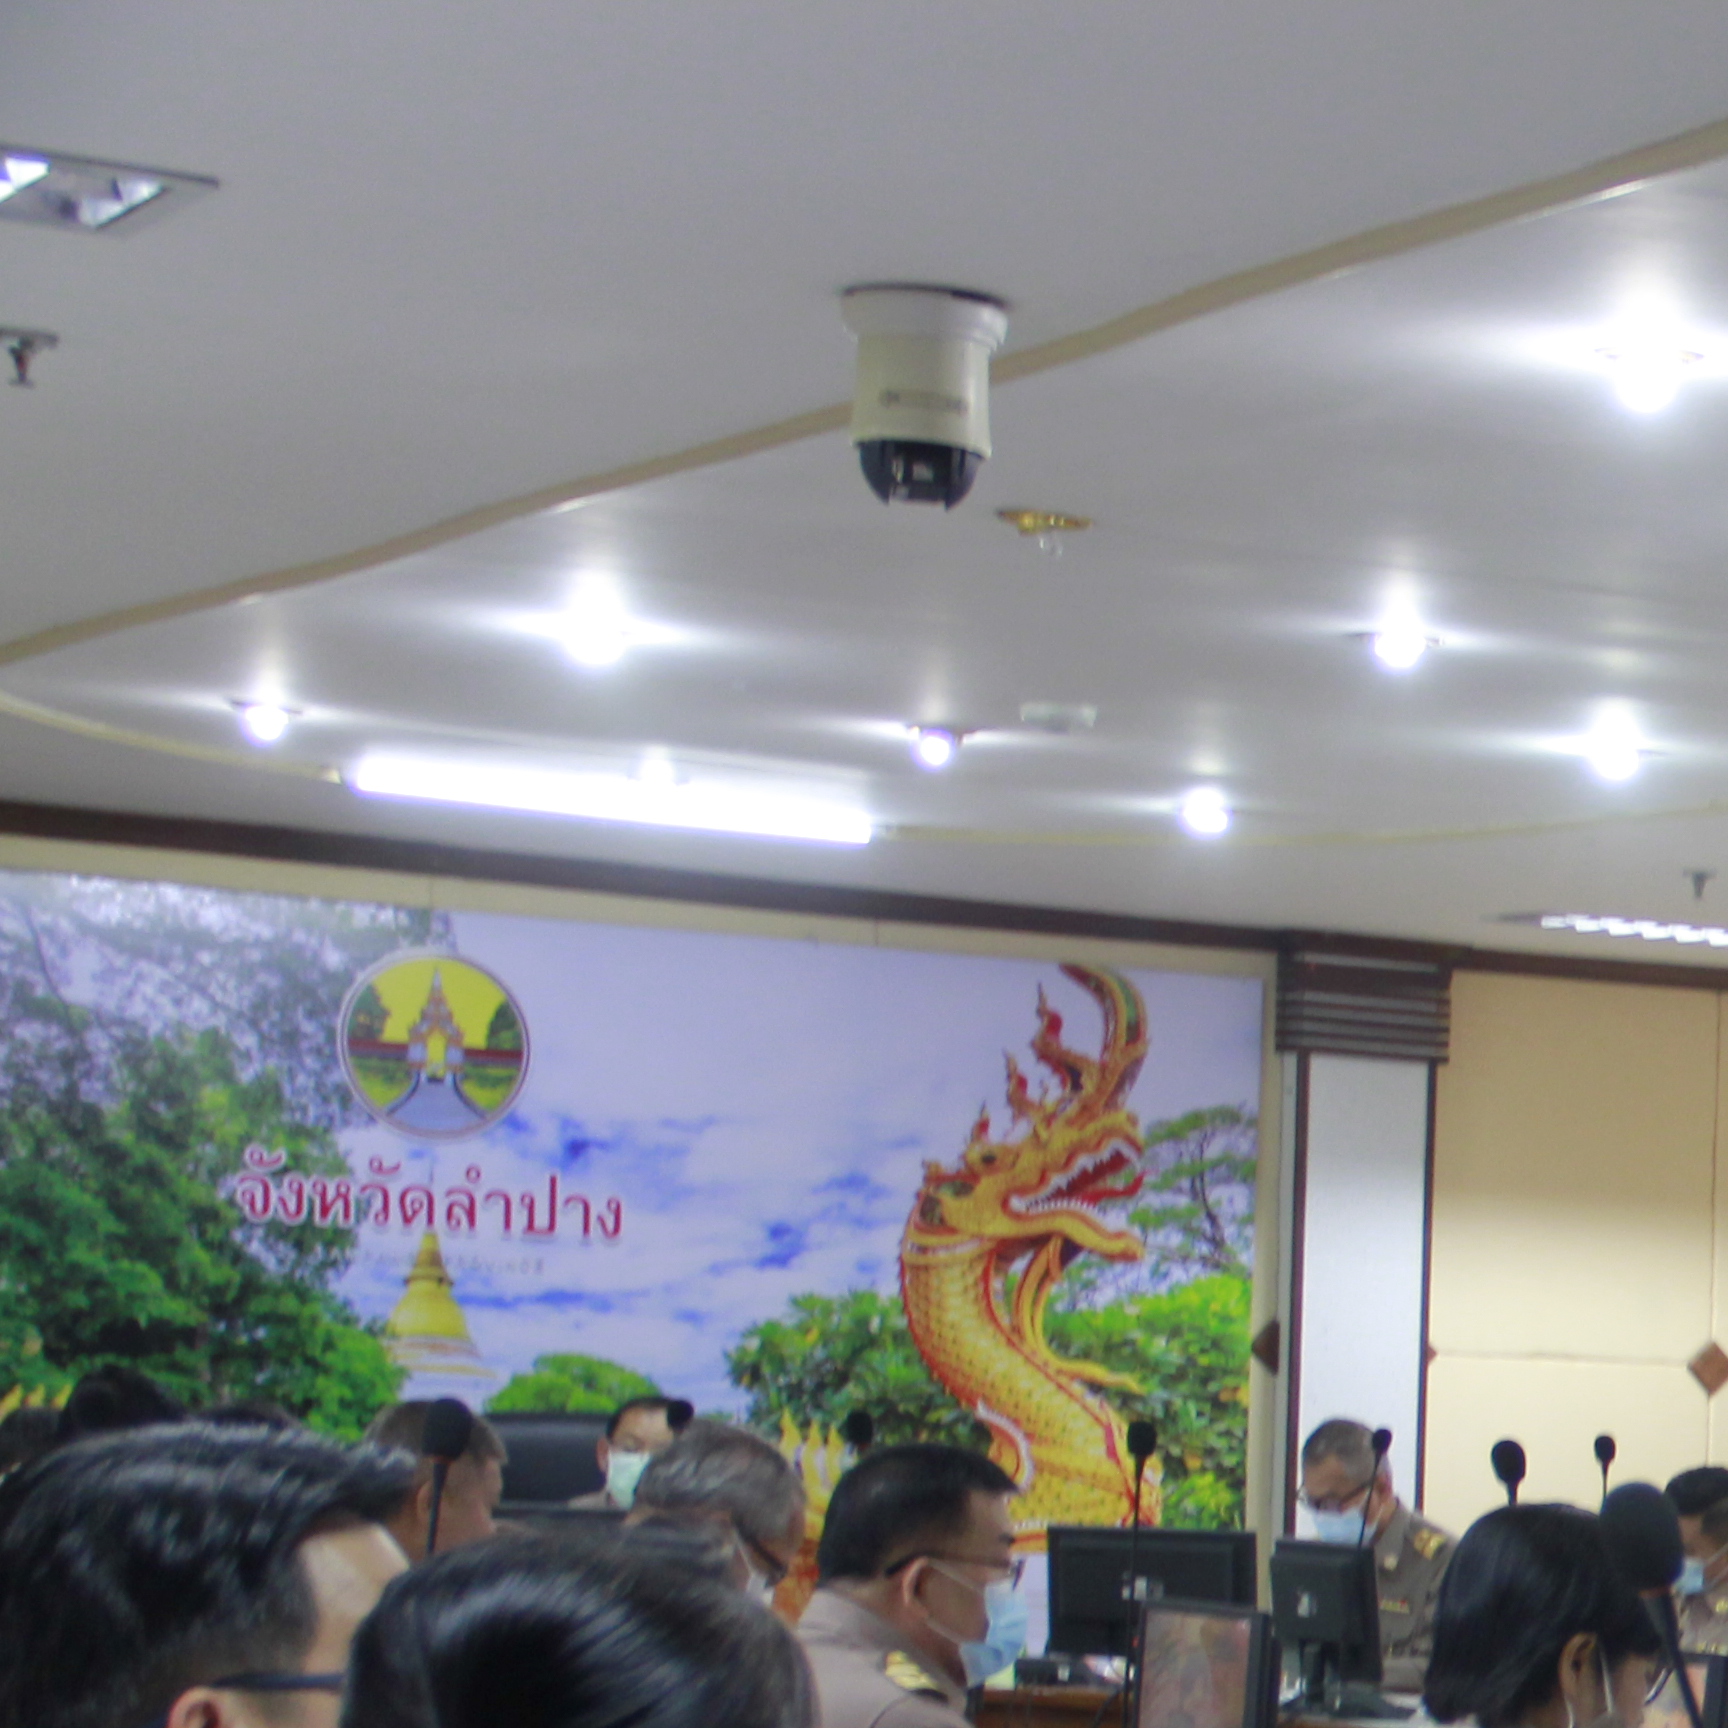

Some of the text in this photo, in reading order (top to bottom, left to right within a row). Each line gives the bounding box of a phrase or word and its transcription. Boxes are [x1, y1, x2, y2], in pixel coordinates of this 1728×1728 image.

[237, 1144, 623, 1239] จังหวัดลำปาง
